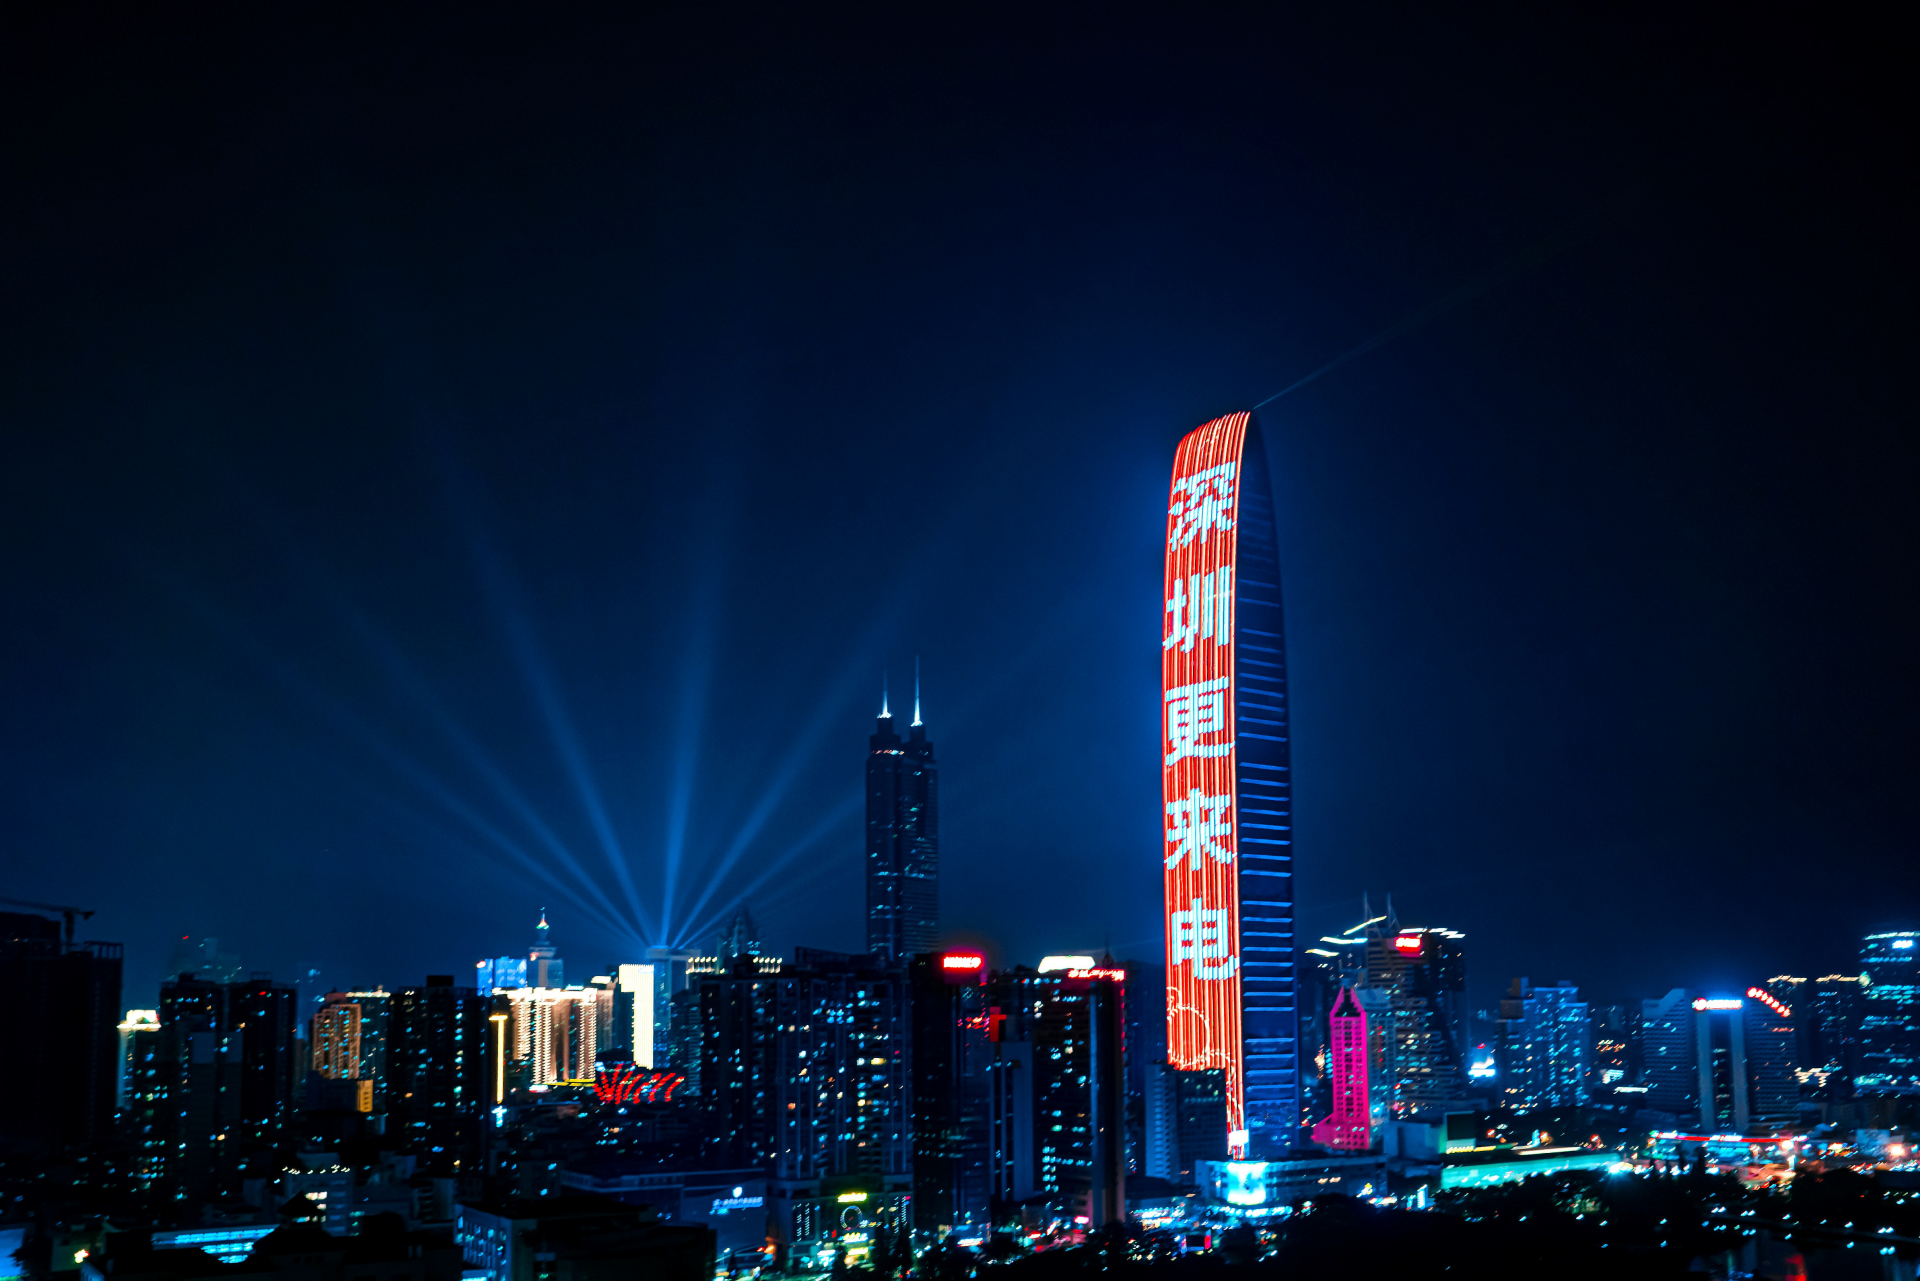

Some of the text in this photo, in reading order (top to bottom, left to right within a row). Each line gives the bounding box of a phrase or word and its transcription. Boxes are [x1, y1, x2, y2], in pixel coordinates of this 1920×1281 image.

[1162, 460, 1240, 981] 深圳更来电
